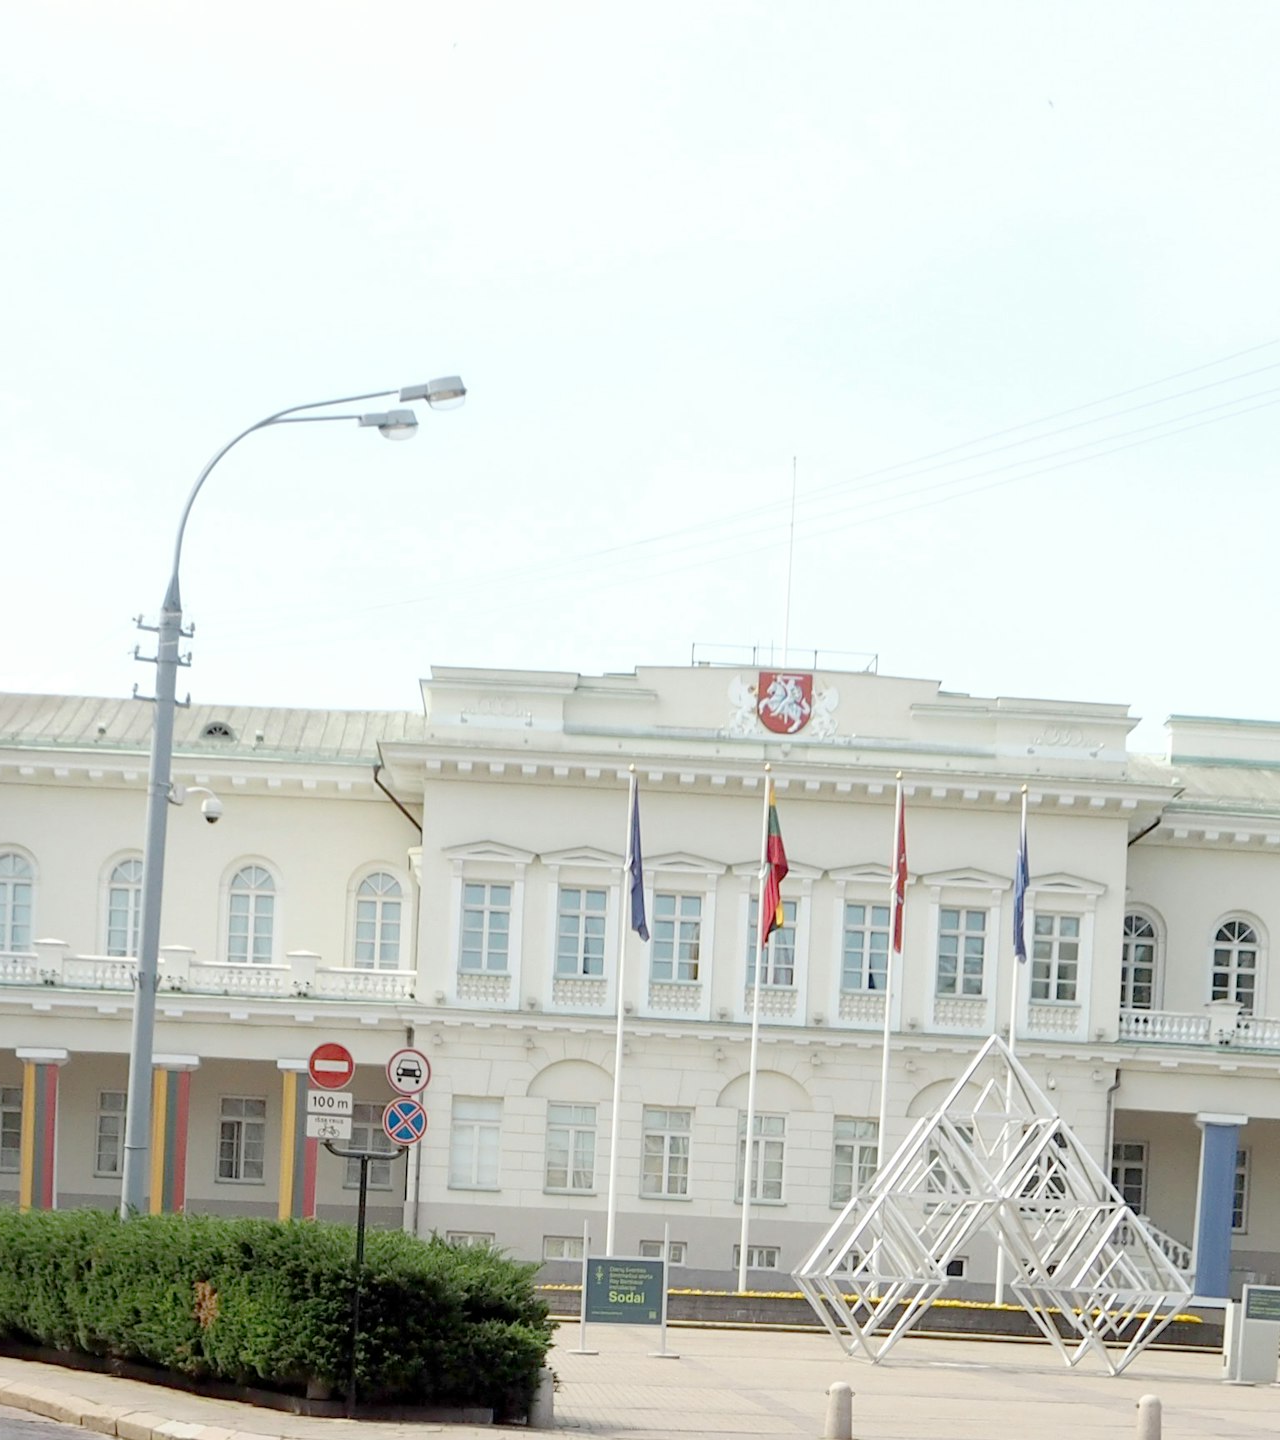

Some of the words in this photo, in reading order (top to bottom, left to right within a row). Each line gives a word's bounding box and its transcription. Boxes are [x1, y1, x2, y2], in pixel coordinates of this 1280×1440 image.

[313, 1096, 335, 1108] 100
[337, 1100, 348, 1109] m
[608, 1290, 645, 1304] Sodai
